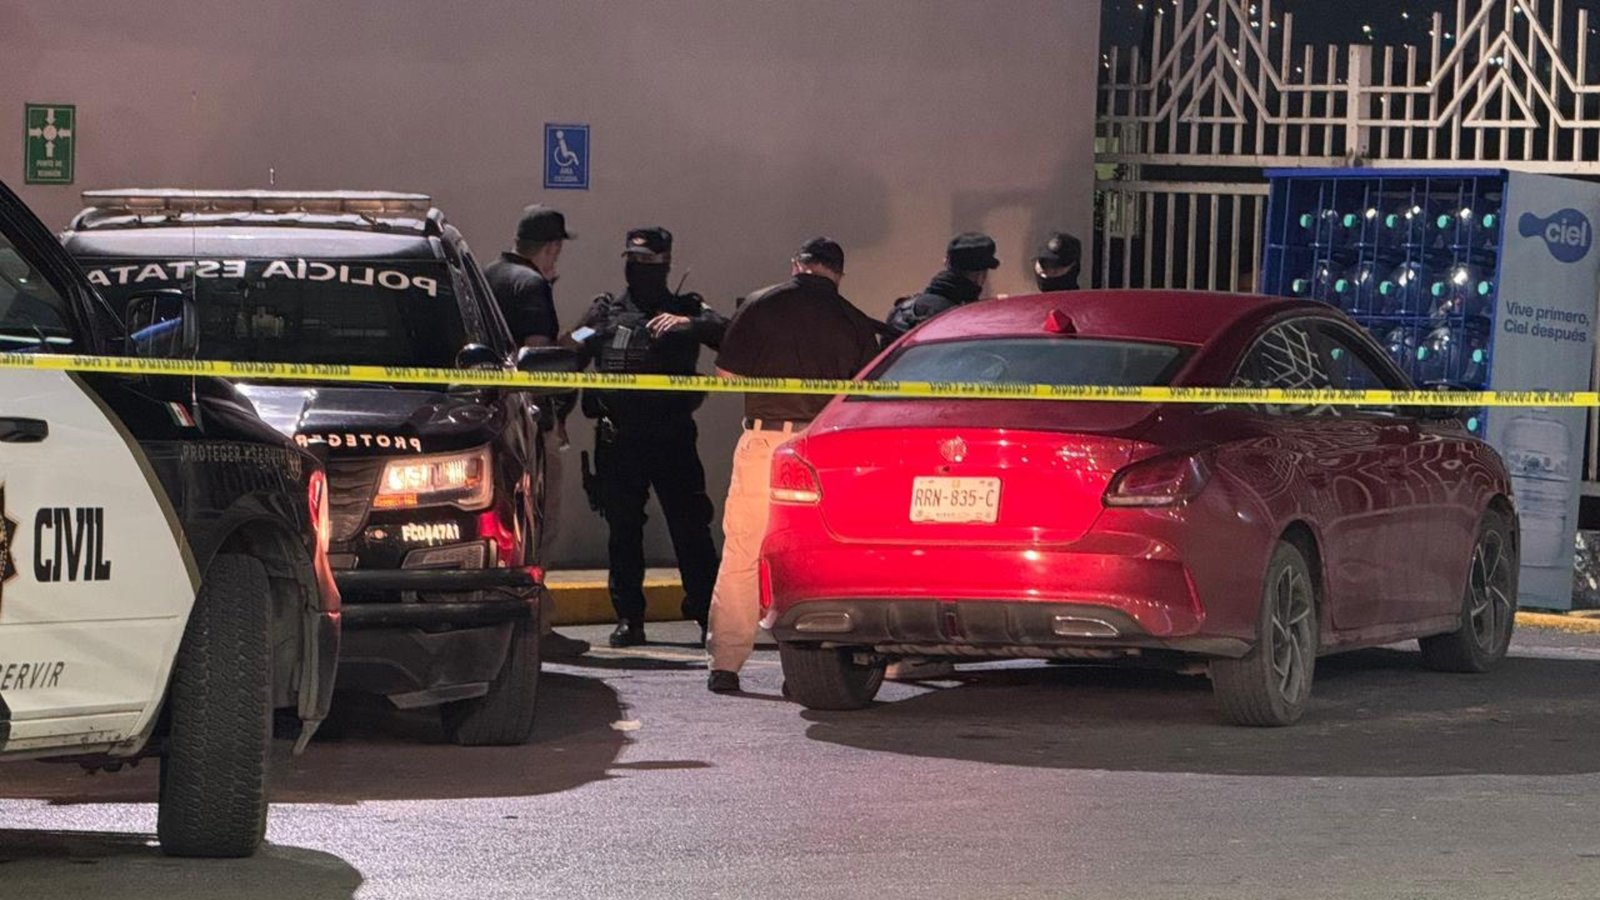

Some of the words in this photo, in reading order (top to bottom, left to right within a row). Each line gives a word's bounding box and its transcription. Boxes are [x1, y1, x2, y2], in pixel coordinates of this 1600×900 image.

[1545, 219, 1587, 247] ciel
[1506, 301, 1533, 317] Vive
[1535, 306, 1590, 327] primero,
[1504, 319, 1528, 334] Ciel
[1531, 323, 1587, 342] después
[182, 444, 242, 463] PROTEGER
[914, 488, 995, 507] RRN-835-C
[33, 507, 112, 582] CIVIL
[0, 661, 65, 690] ERVIR
